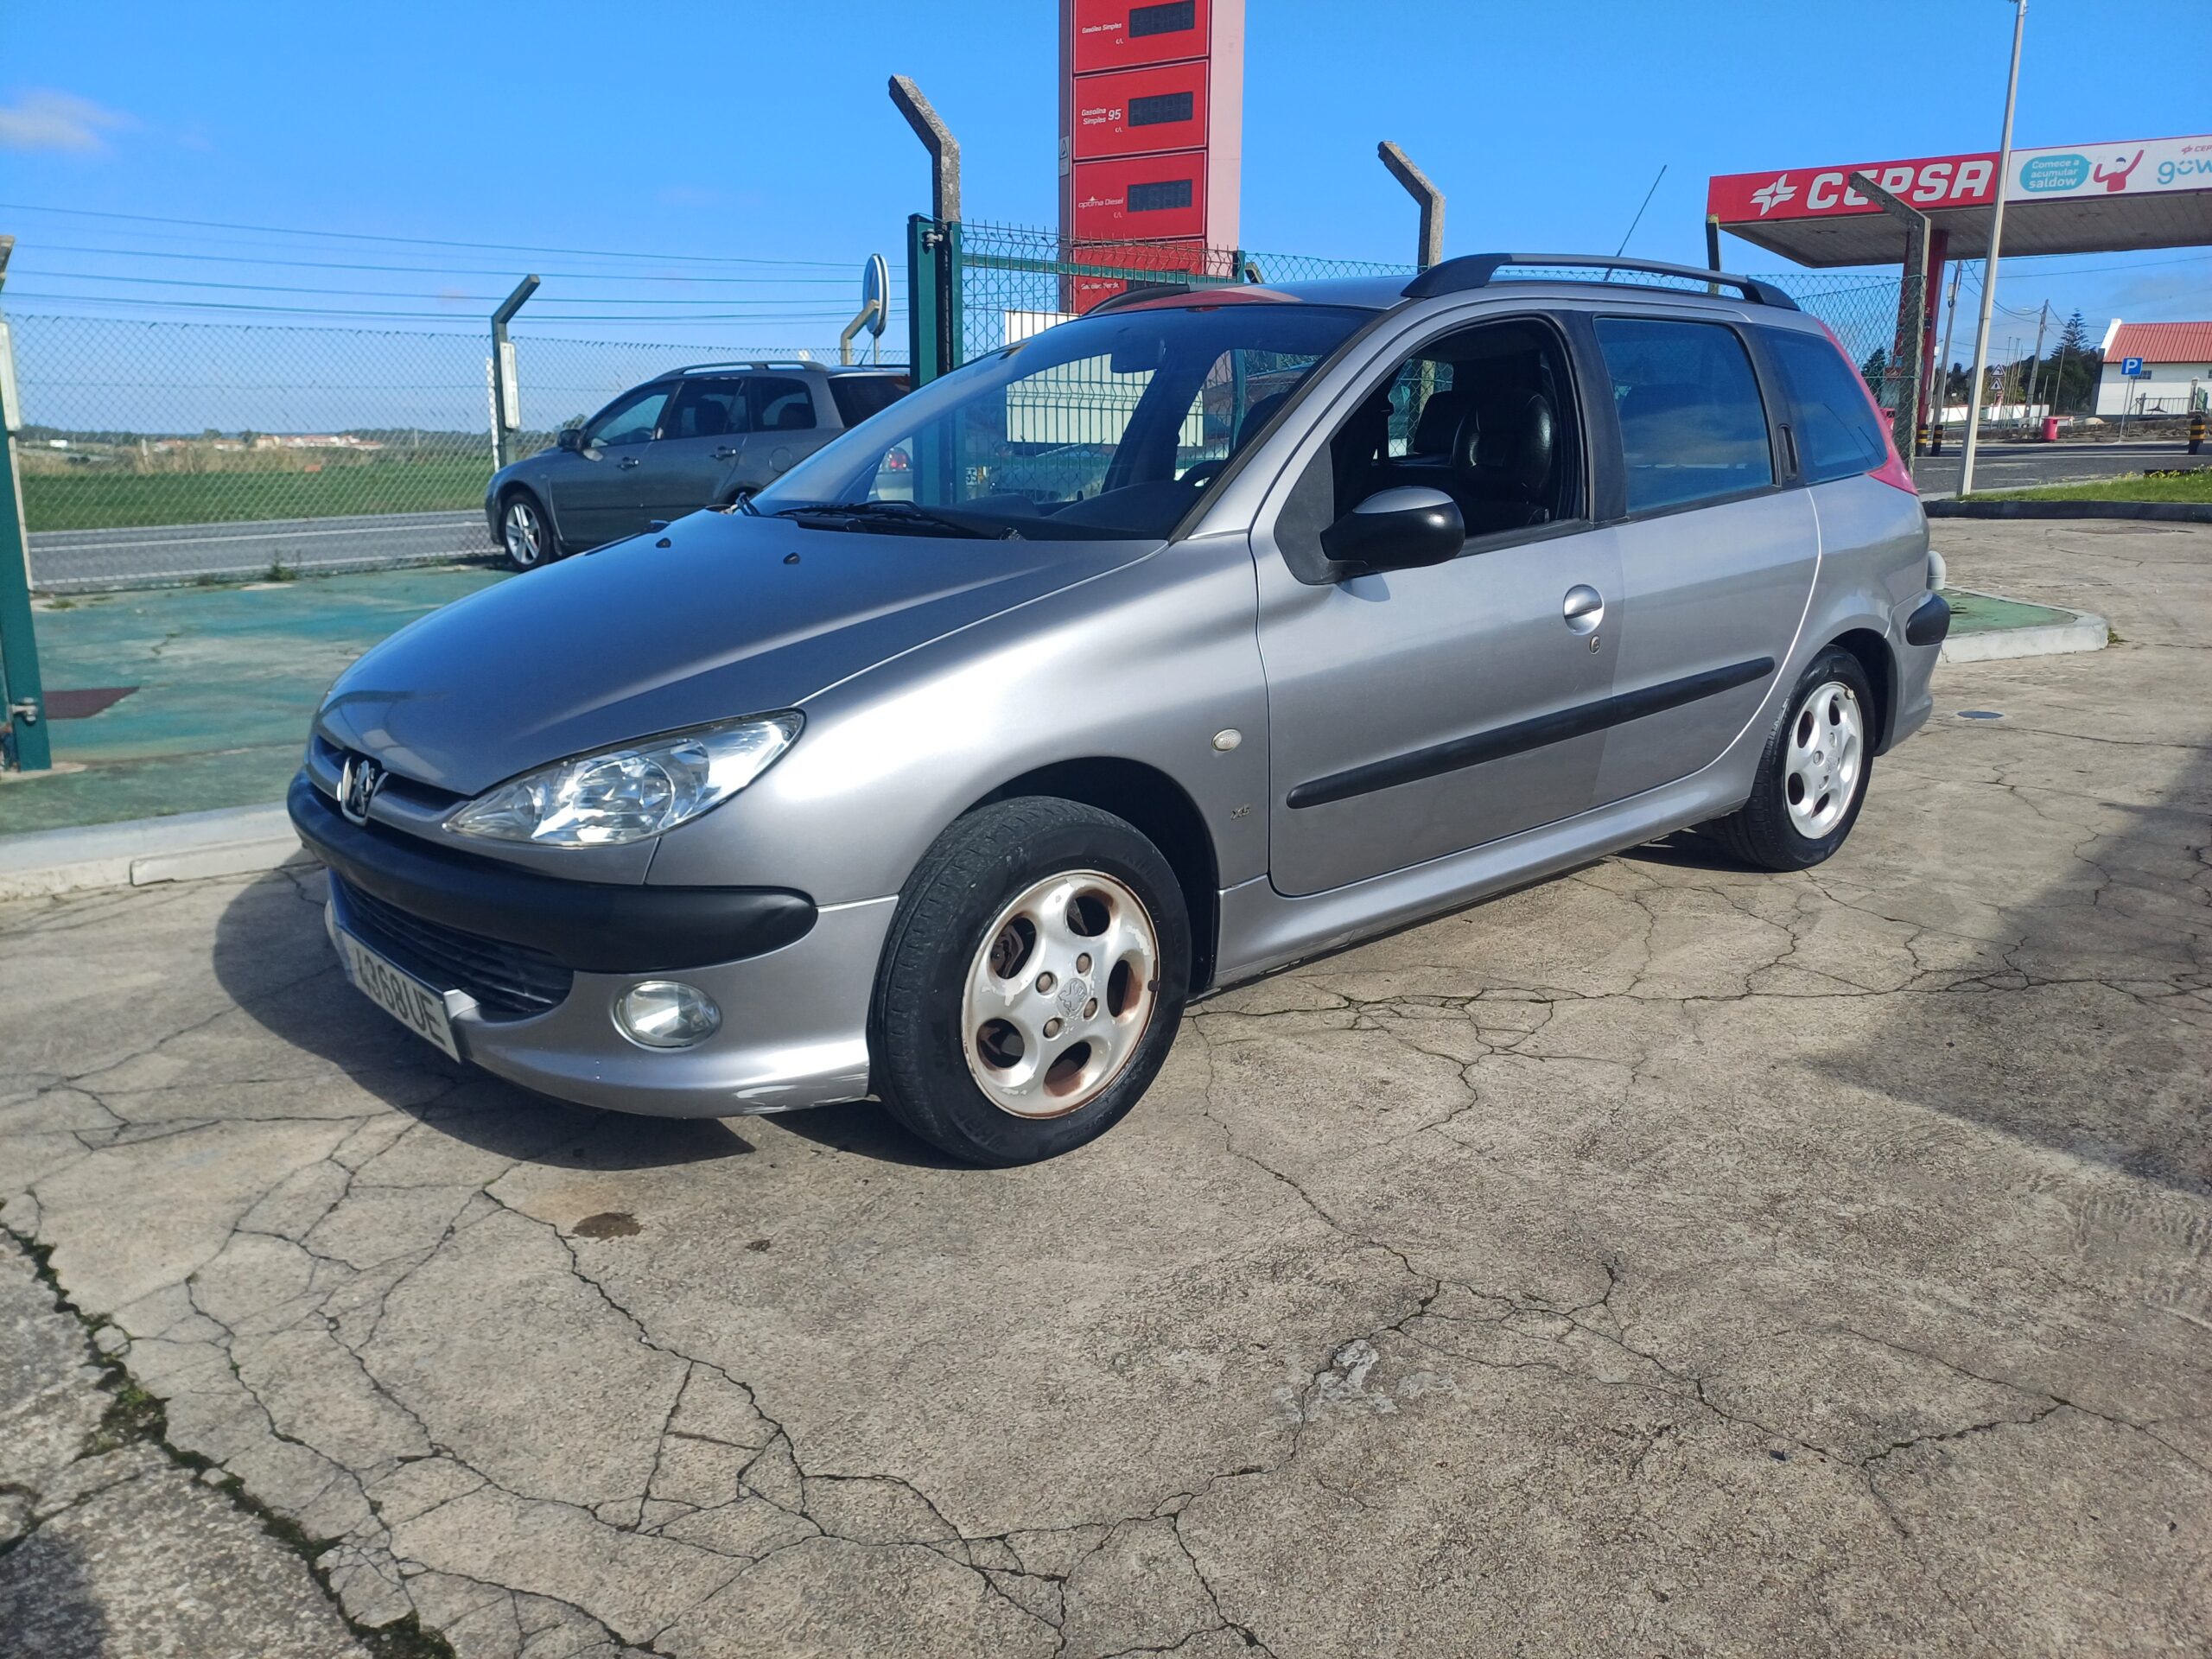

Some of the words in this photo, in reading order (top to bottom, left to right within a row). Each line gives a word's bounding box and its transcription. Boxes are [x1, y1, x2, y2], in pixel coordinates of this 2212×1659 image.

[1108, 109, 1122, 120] 95
[1083, 117, 1106, 125] Simples
[2031, 160, 2072, 169] Comece
[2031, 168, 2079, 178] acumular
[2028, 177, 2077, 189] saldow
[1105, 196, 1124, 206] Diesel
[2125, 359, 2139, 374] P
